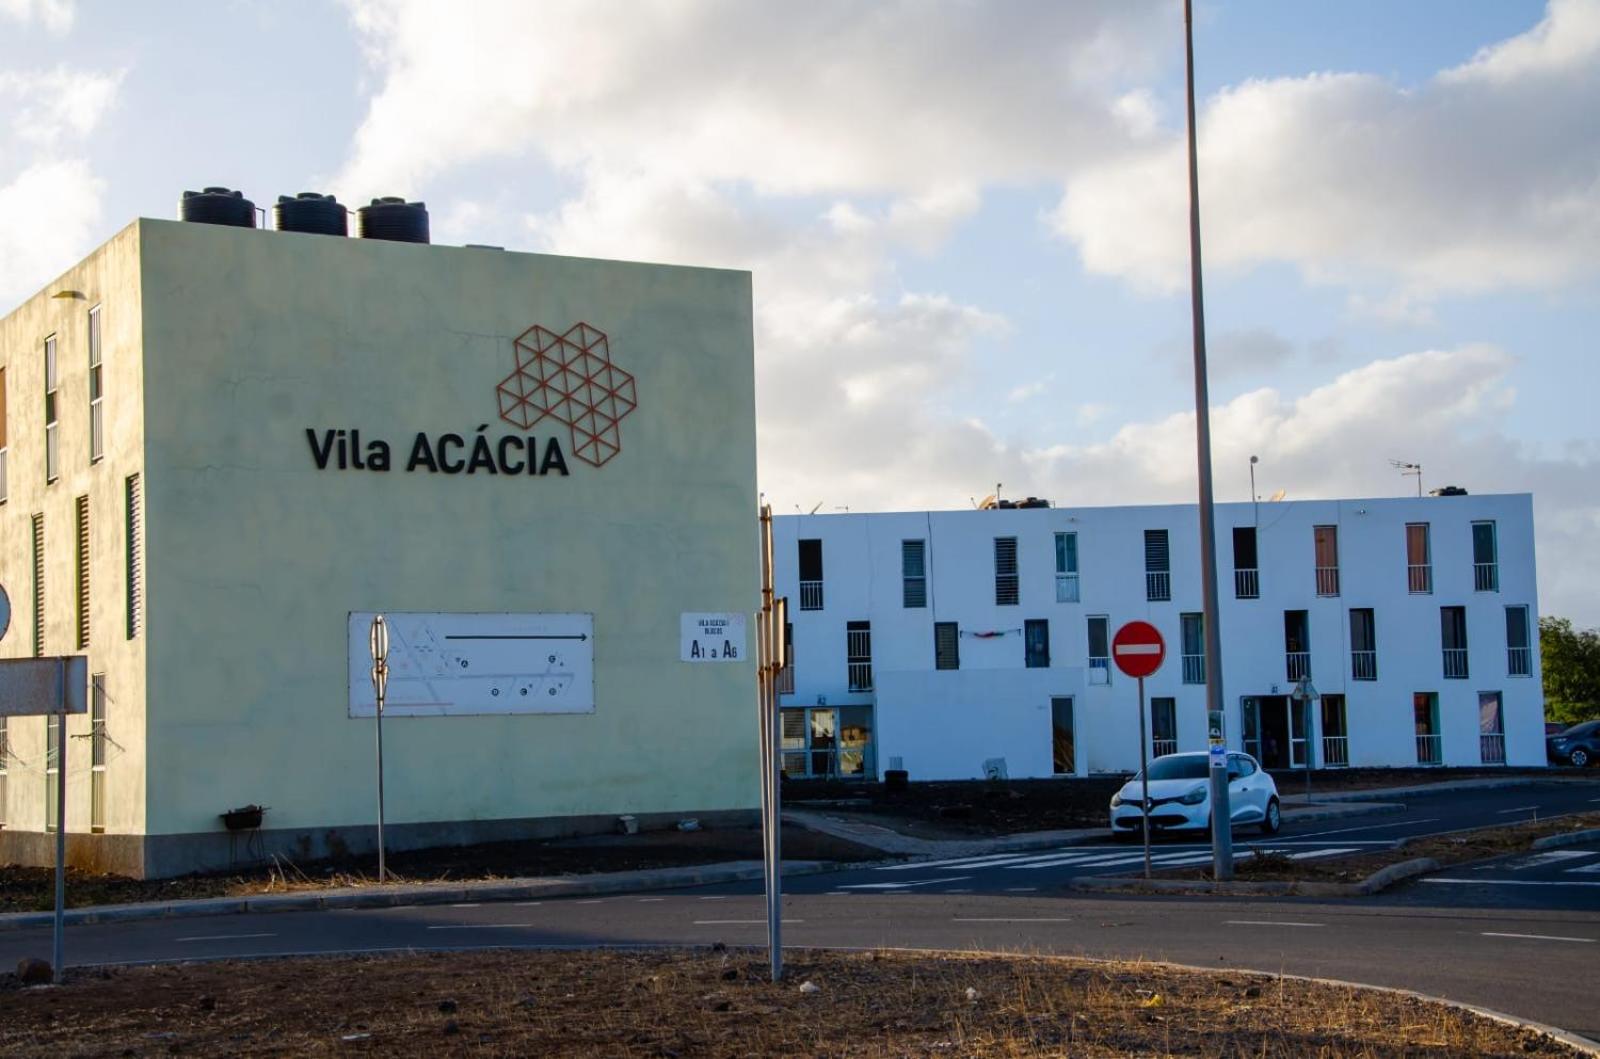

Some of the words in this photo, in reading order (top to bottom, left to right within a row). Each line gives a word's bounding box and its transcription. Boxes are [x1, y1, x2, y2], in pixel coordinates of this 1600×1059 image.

[306, 428, 391, 472] Vila
[406, 424, 569, 476] ACÁCIA
[691, 640, 705, 658] A1
[711, 648, 717, 658] a
[723, 640, 737, 658] A6
